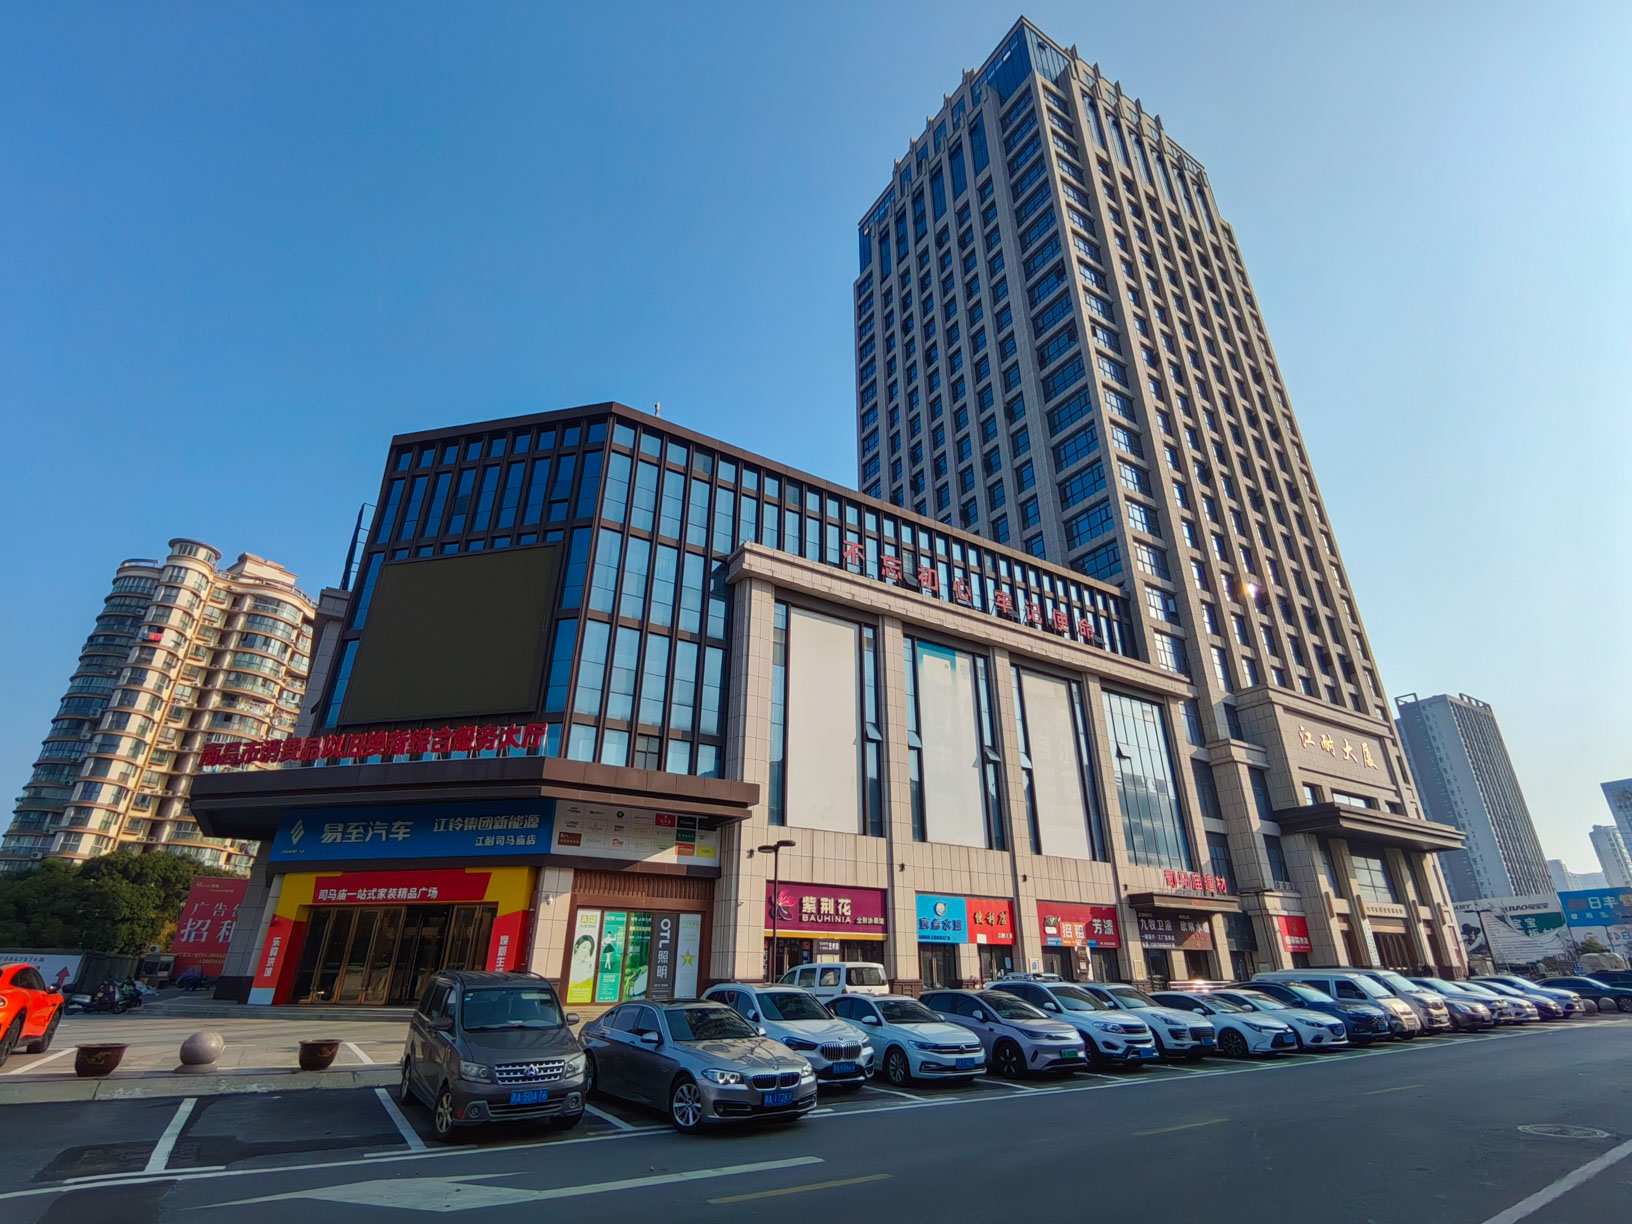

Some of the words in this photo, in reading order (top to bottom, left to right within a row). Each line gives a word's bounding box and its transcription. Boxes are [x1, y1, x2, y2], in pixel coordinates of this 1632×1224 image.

[198, 722, 548, 768] 南昌市消费品以旧换新综合服务大厅
[320, 820, 414, 844] 易至汽车
[433, 814, 541, 833] 江铃集团新能源
[475, 834, 537, 847] 江耐司马庙店
[1164, 869, 1227, 893] 司马庙建材
[318, 887, 439, 901] 司马庙一站式家装精品广场
[801, 895, 852, 916] 紫荆花
[801, 914, 852, 923] BAUHINIA
[974, 911, 1007, 926] 便利店
[1139, 918, 1172, 931] 九牧卫浴
[658, 918, 672, 948] OTL
[656, 950, 669, 979] 照明
